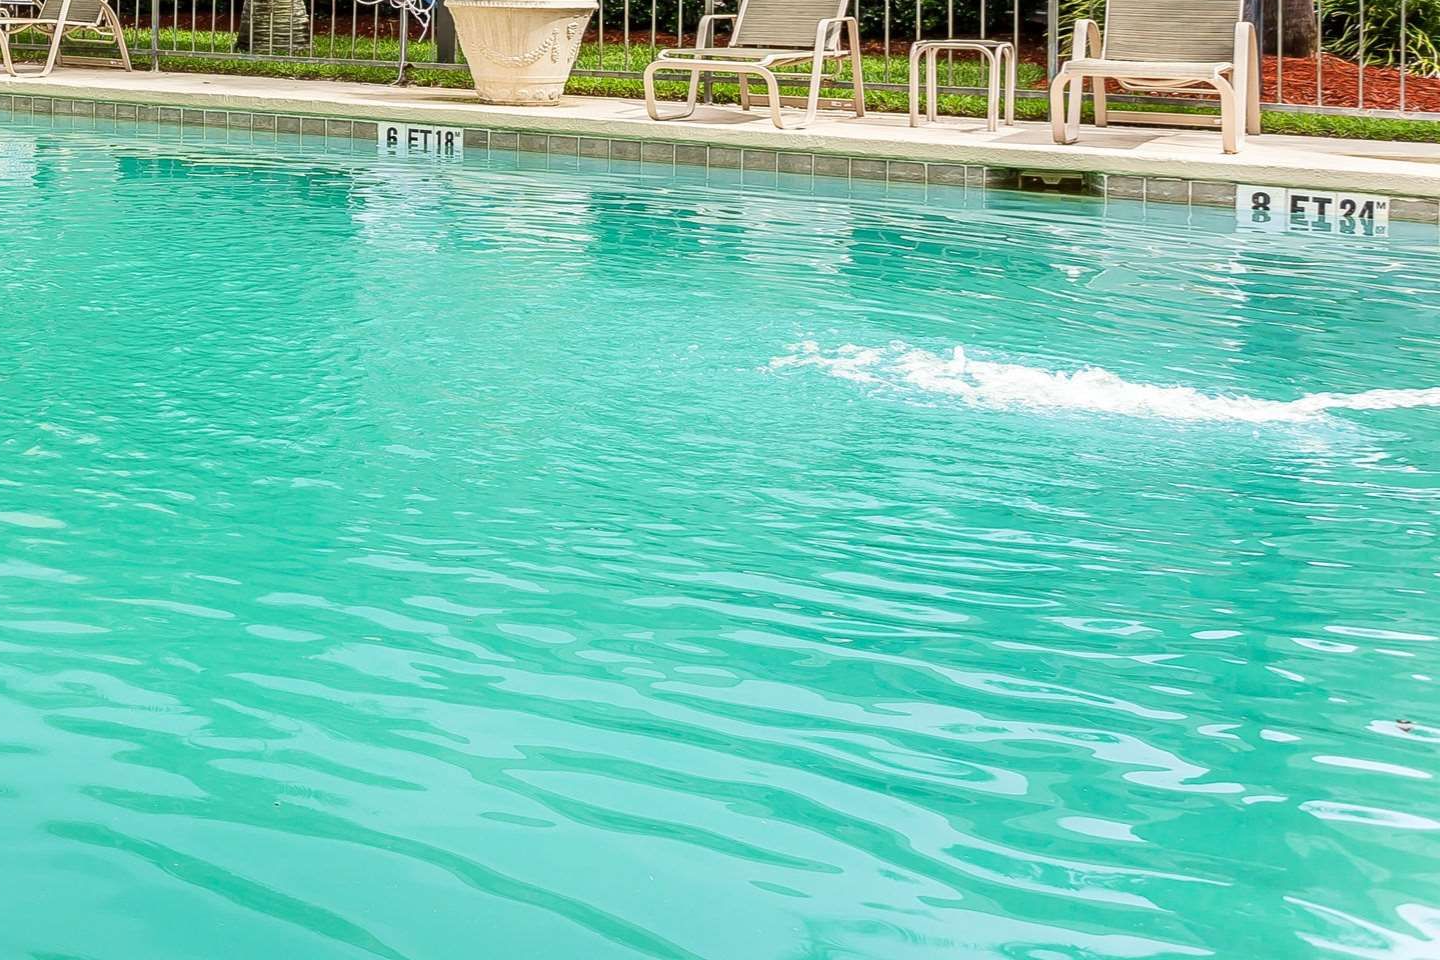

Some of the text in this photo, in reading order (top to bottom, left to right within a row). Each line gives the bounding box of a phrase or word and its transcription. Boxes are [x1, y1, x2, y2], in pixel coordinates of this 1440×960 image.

[386, 127, 398, 147] 6
[408, 128, 433, 150] FT
[1251, 192, 1271, 218] 8
[1290, 195, 1333, 223] FT
